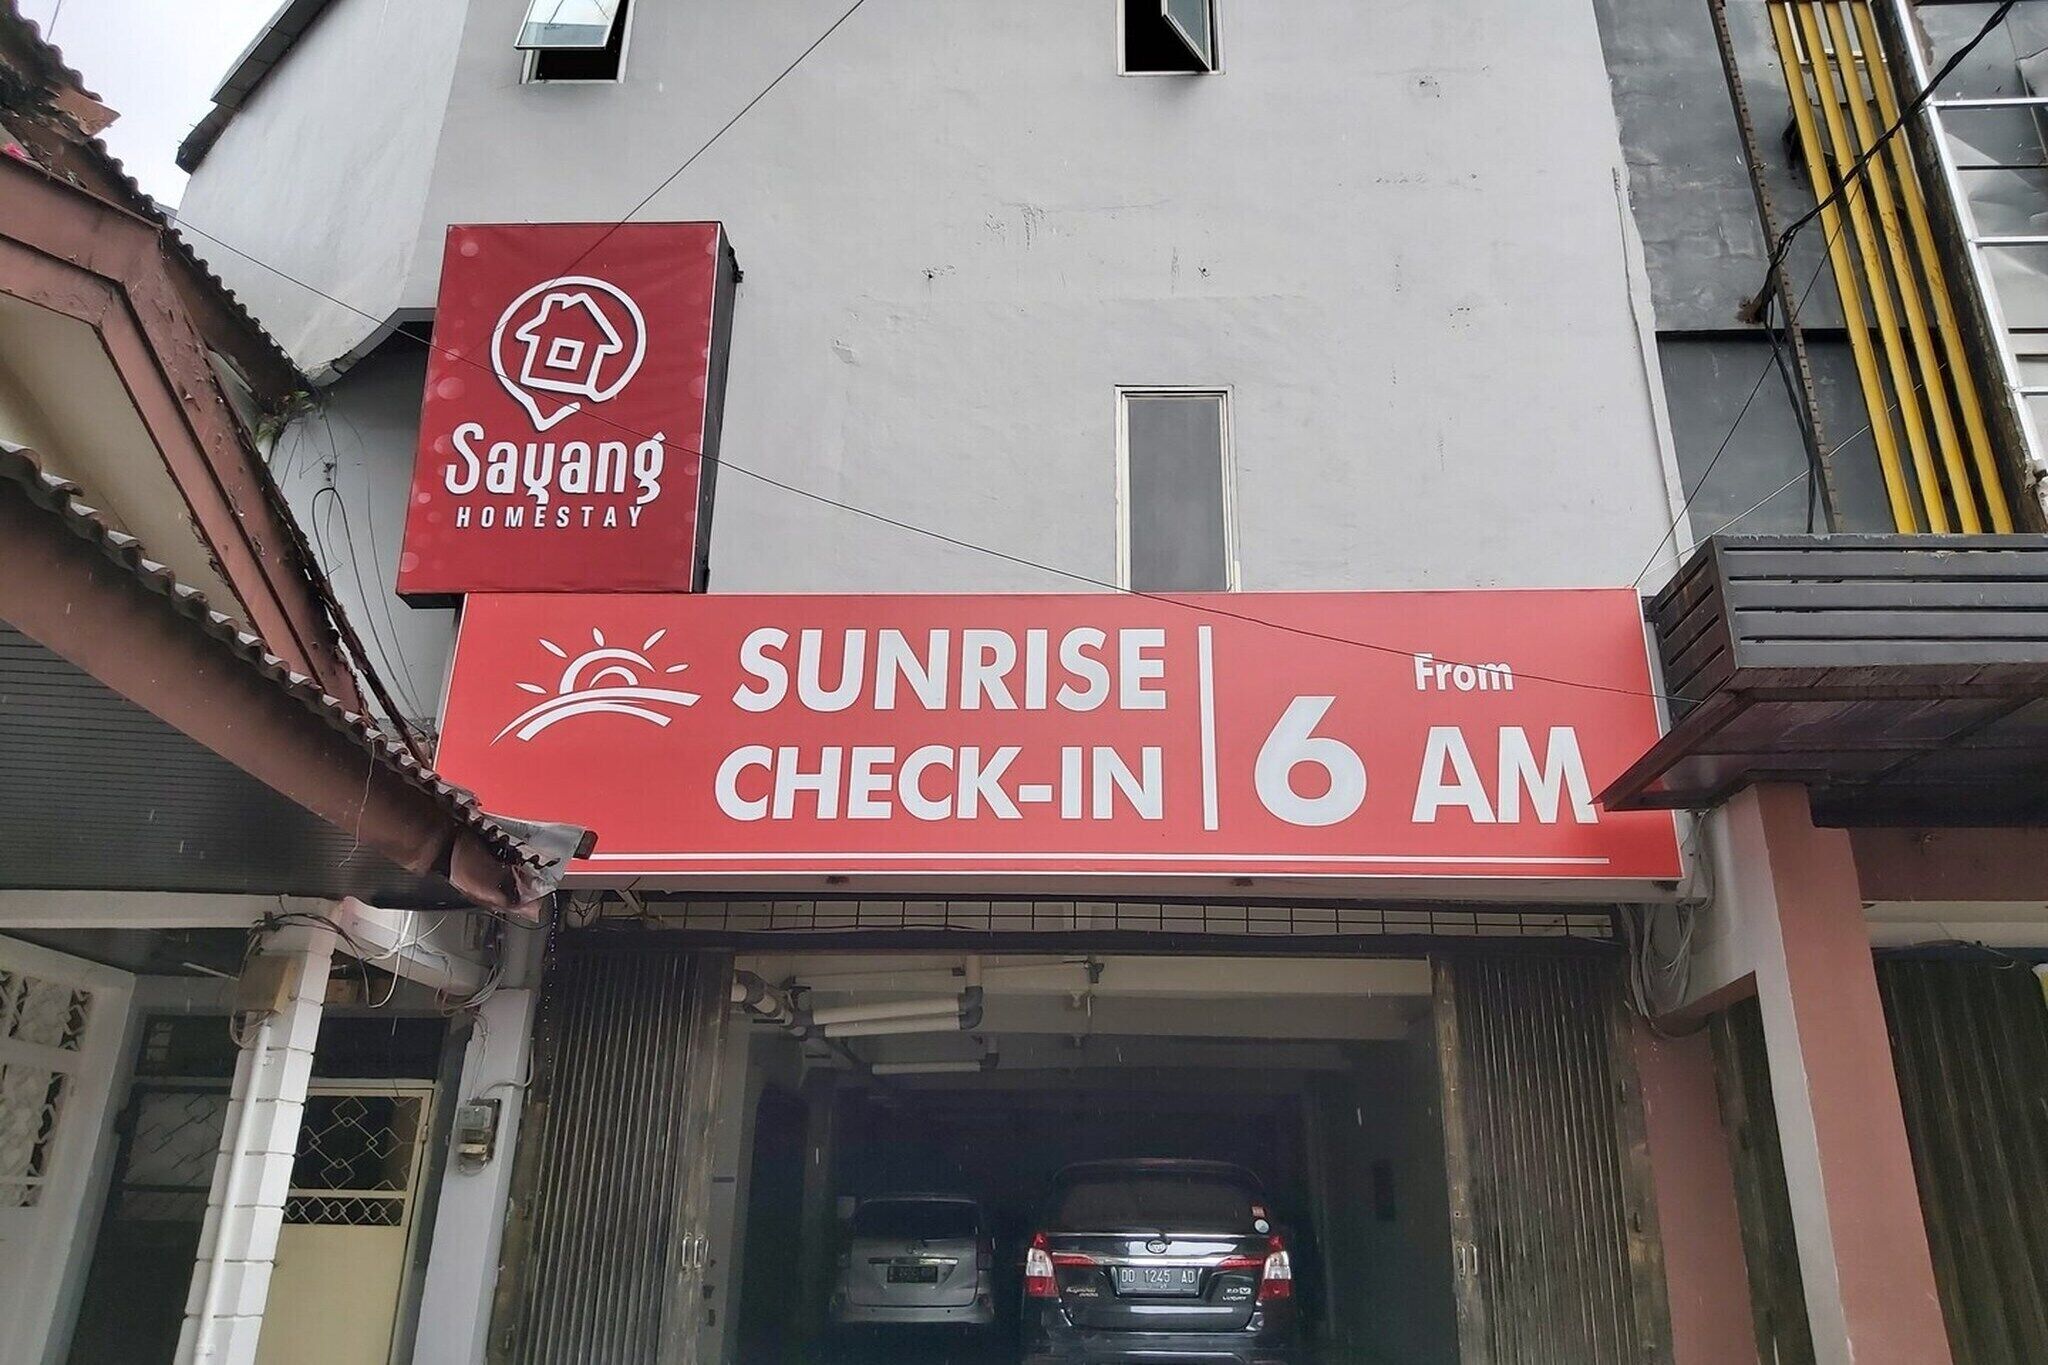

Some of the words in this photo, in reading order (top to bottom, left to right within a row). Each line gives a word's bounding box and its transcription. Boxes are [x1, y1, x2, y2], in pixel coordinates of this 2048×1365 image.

[444, 422, 667, 505] Sayang
[455, 506, 644, 528] HOMESTAY
[731, 627, 1168, 712] SUNRISE
[1412, 652, 1515, 692] From
[714, 744, 1164, 821] CHECK-IN
[1253, 695, 1368, 827] 6
[1411, 726, 1600, 824] AM
[1145, 1269, 1171, 1283] 1245
